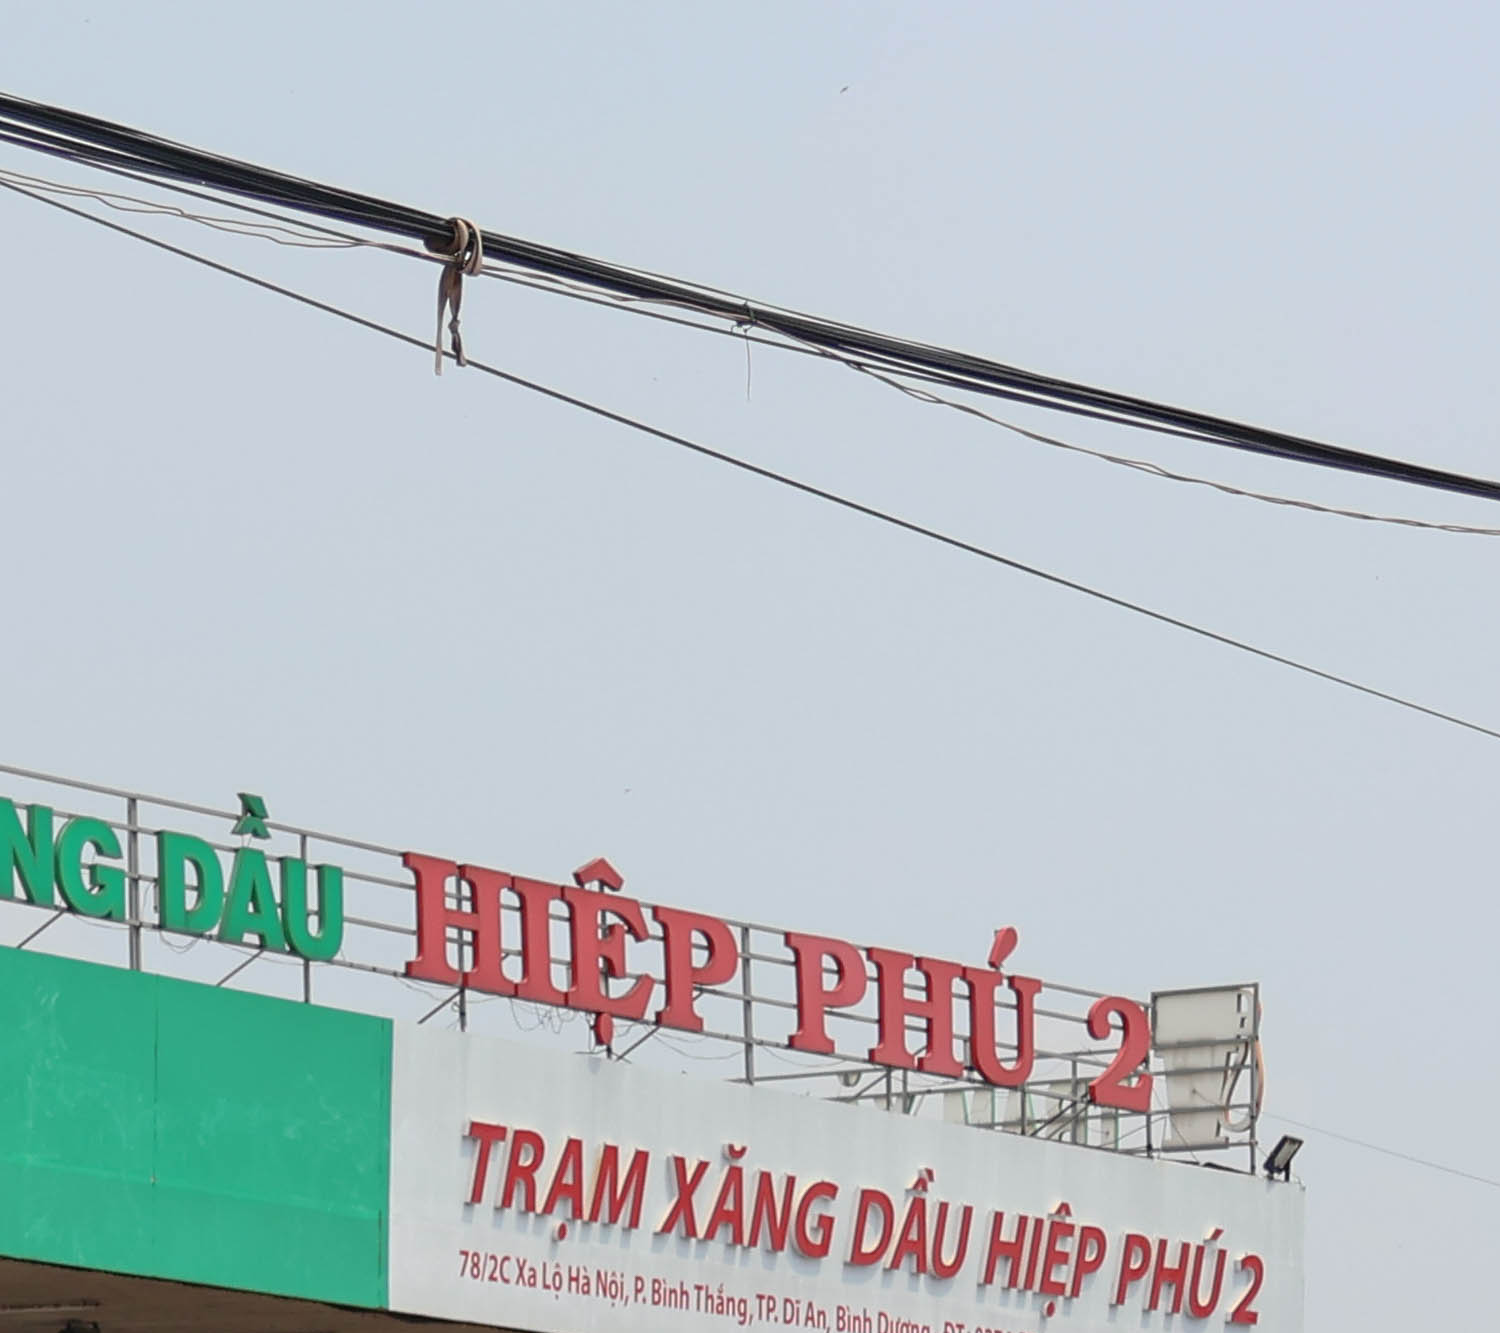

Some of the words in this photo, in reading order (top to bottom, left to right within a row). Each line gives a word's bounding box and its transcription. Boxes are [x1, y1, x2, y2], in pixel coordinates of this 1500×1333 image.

[154, 792, 344, 960] DẦU
[401, 852, 739, 1047] HIỆP
[784, 927, 1042, 1088] PHÚ
[1085, 996, 1154, 1112] 2
[459, 1250, 511, 1285] 78/2C
[515, 1258, 538, 1289] Xa
[542, 1261, 562, 1300] Lộ
[568, 1265, 591, 1296] Hà
[596, 1268, 630, 1308] Nội,
[634, 1276, 647, 1305] P.
[651, 1278, 690, 1312] Bình
[756, 1293, 781, 1324] TP.
[465, 1120, 650, 1242] TRẠM
[655, 1143, 840, 1260] XĂNG
[846, 1166, 974, 1279] DẦU
[979, 1201, 1108, 1317] HIỆP
[1112, 1227, 1227, 1319] PHÚ
[1228, 1254, 1264, 1325] 2
